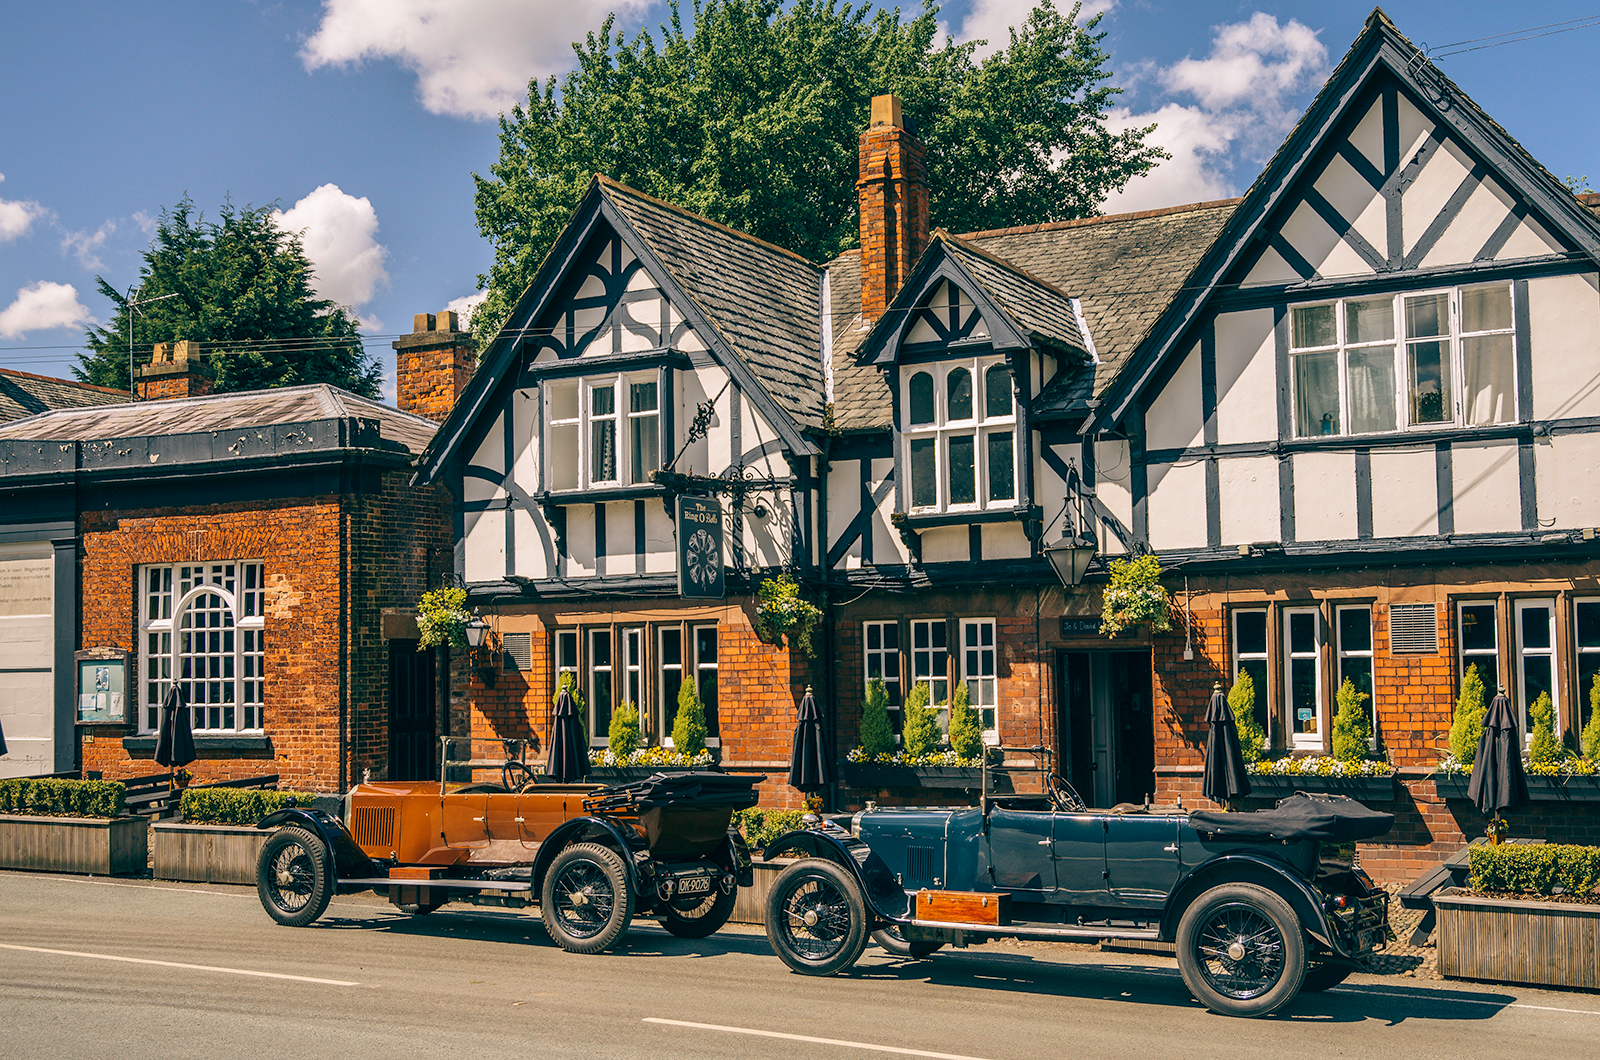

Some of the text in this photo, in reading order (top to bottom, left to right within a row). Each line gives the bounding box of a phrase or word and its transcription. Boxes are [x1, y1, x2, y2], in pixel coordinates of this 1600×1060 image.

[695, 503, 706, 511] The
[684, 510, 718, 524] Ring O Bells
[1063, 621, 1072, 631] Jo
[1073, 621, 1078, 630] &
[680, 878, 709, 892] OK-9076
